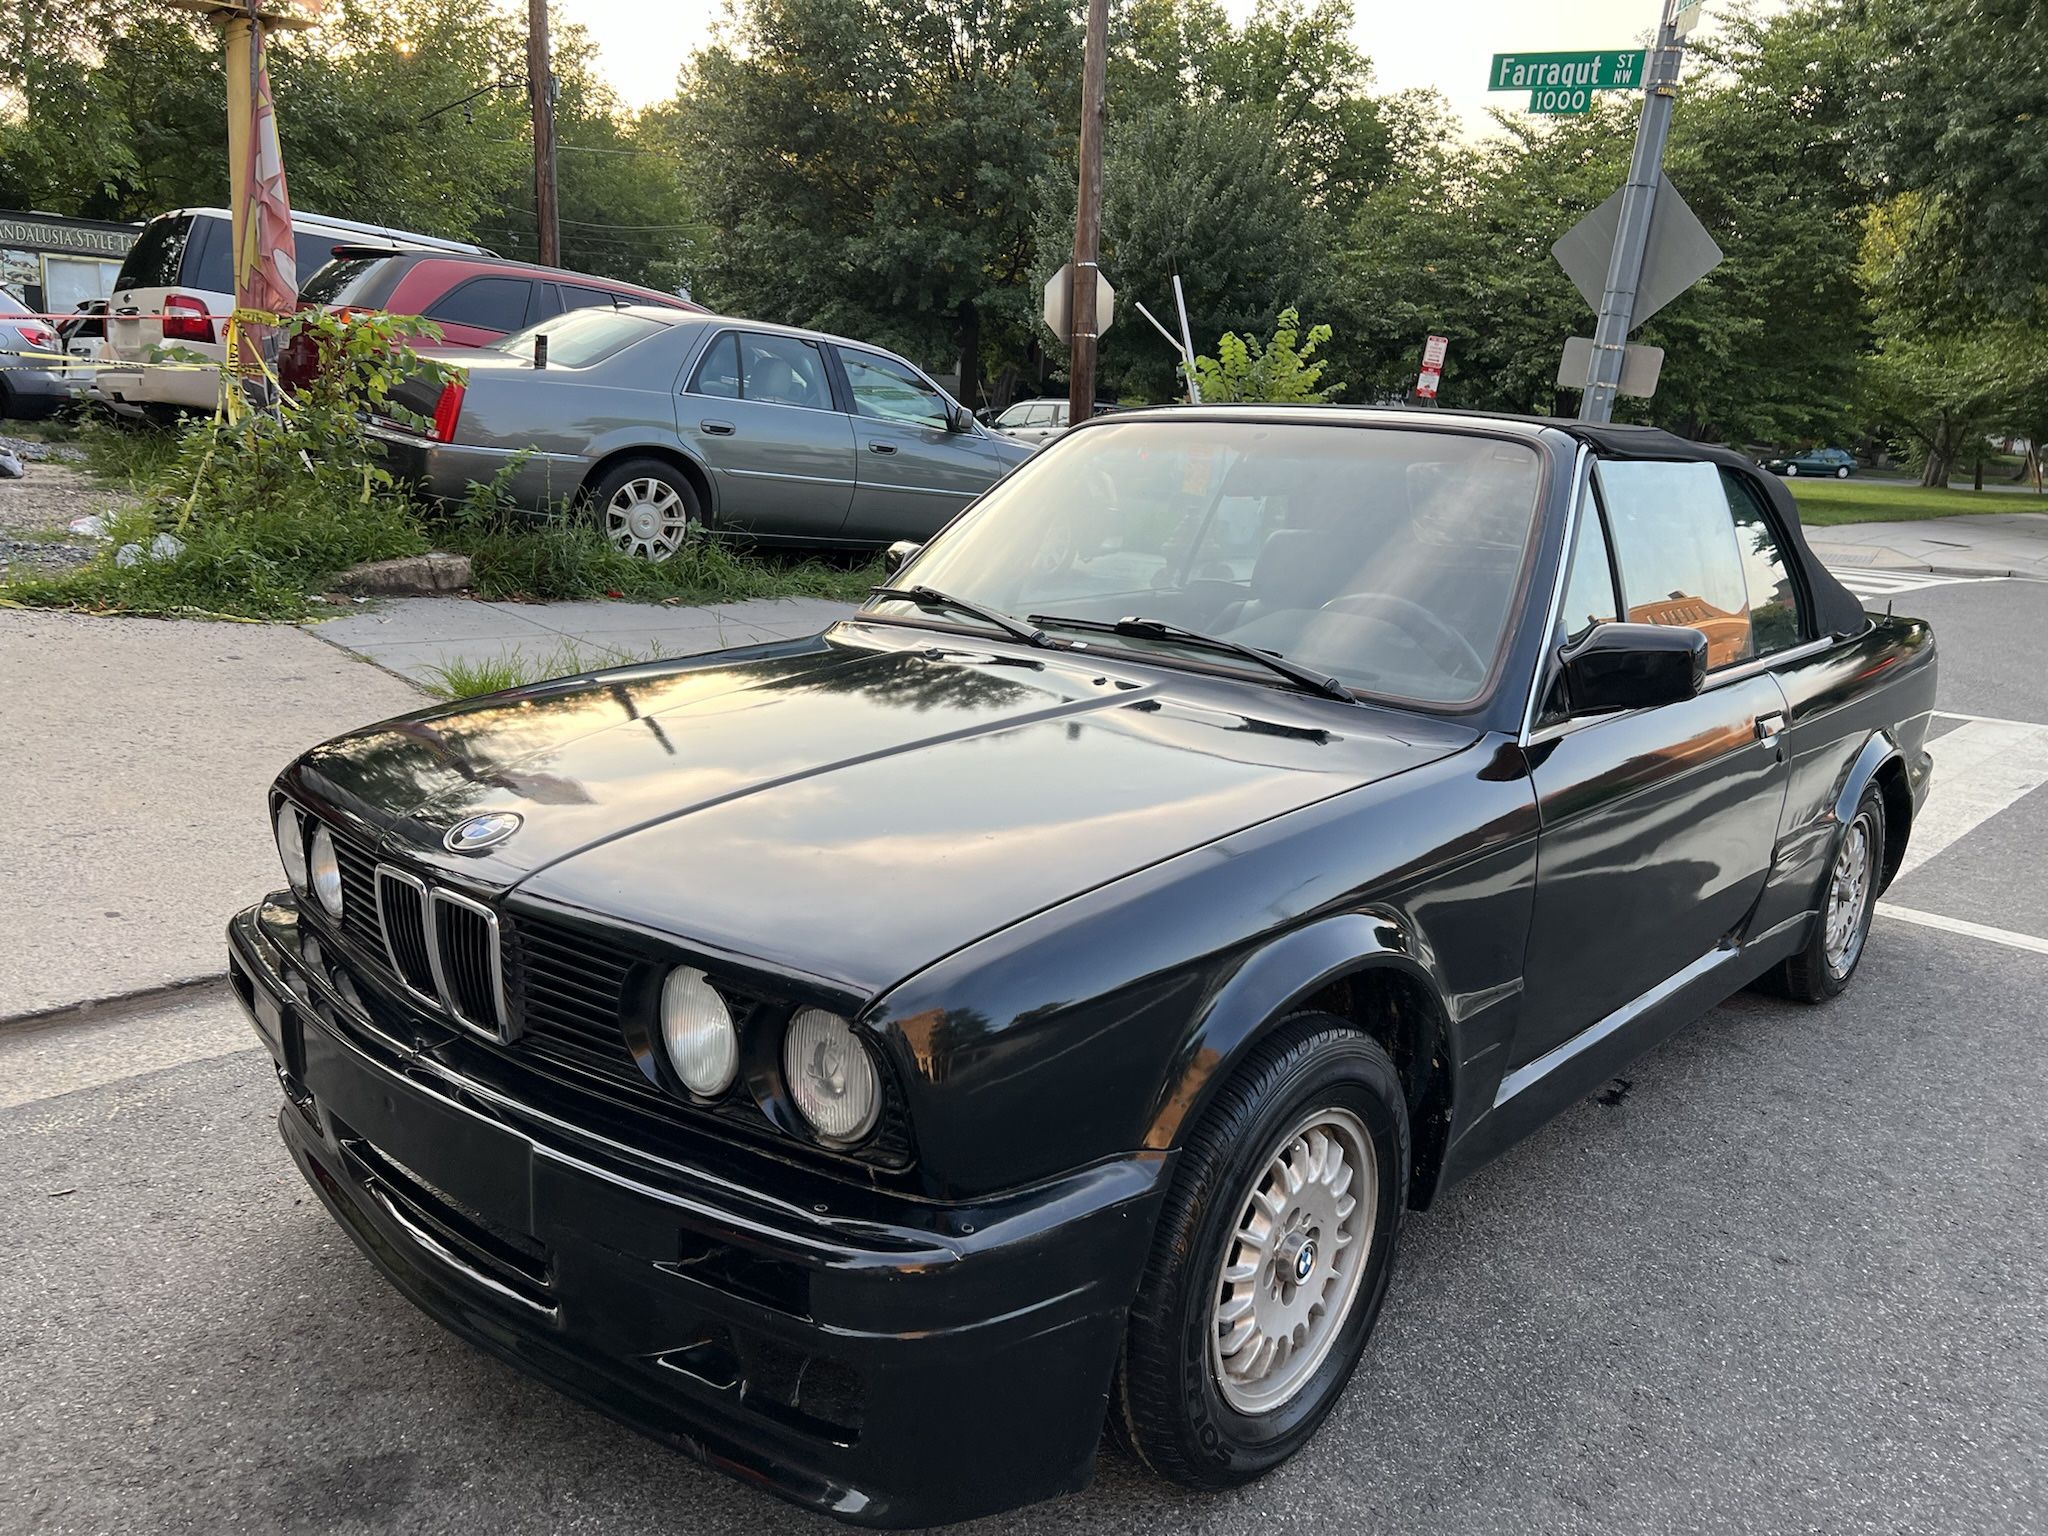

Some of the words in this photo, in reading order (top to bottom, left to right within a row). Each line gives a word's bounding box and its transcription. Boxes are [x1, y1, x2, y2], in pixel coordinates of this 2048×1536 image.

[1617, 54, 1636, 69] ST
[1613, 69, 1633, 84] NW
[1536, 90, 1585, 110] 1000
